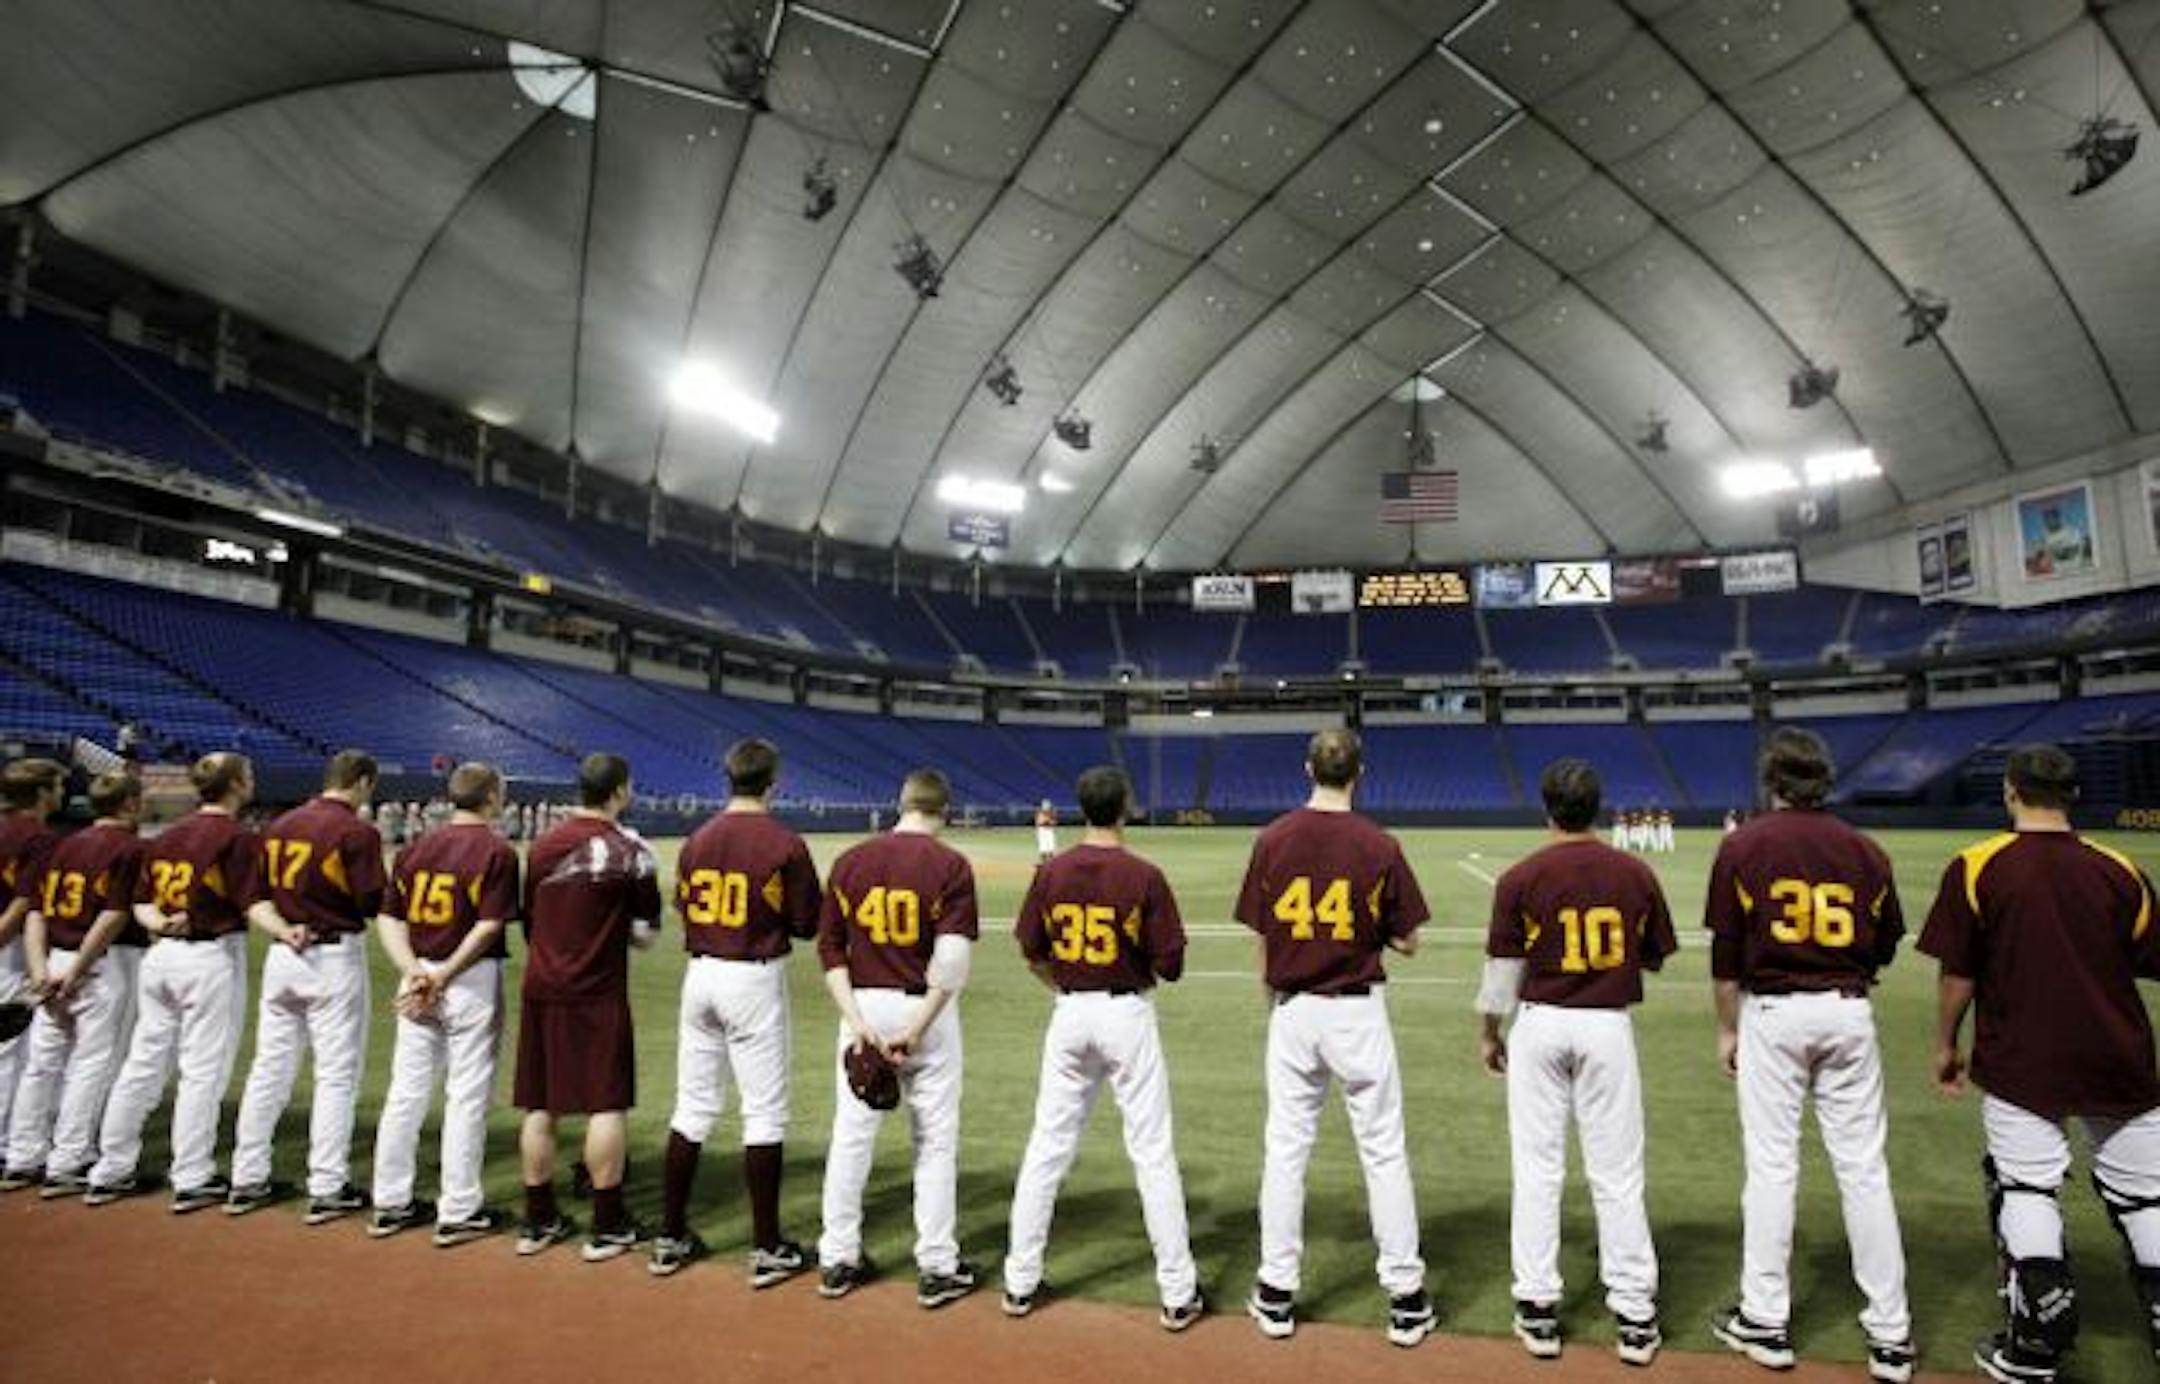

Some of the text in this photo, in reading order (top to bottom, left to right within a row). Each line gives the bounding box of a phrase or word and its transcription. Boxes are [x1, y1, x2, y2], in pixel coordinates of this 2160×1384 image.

[42, 870, 86, 918] 13
[264, 838, 313, 890] 17
[407, 870, 457, 925] 15
[686, 868, 749, 928] 30
[855, 888, 920, 946] 40
[1273, 876, 1354, 941] 44
[1769, 878, 1855, 948] 36
[1051, 903, 1118, 965] 35
[1558, 906, 1625, 972] 10
